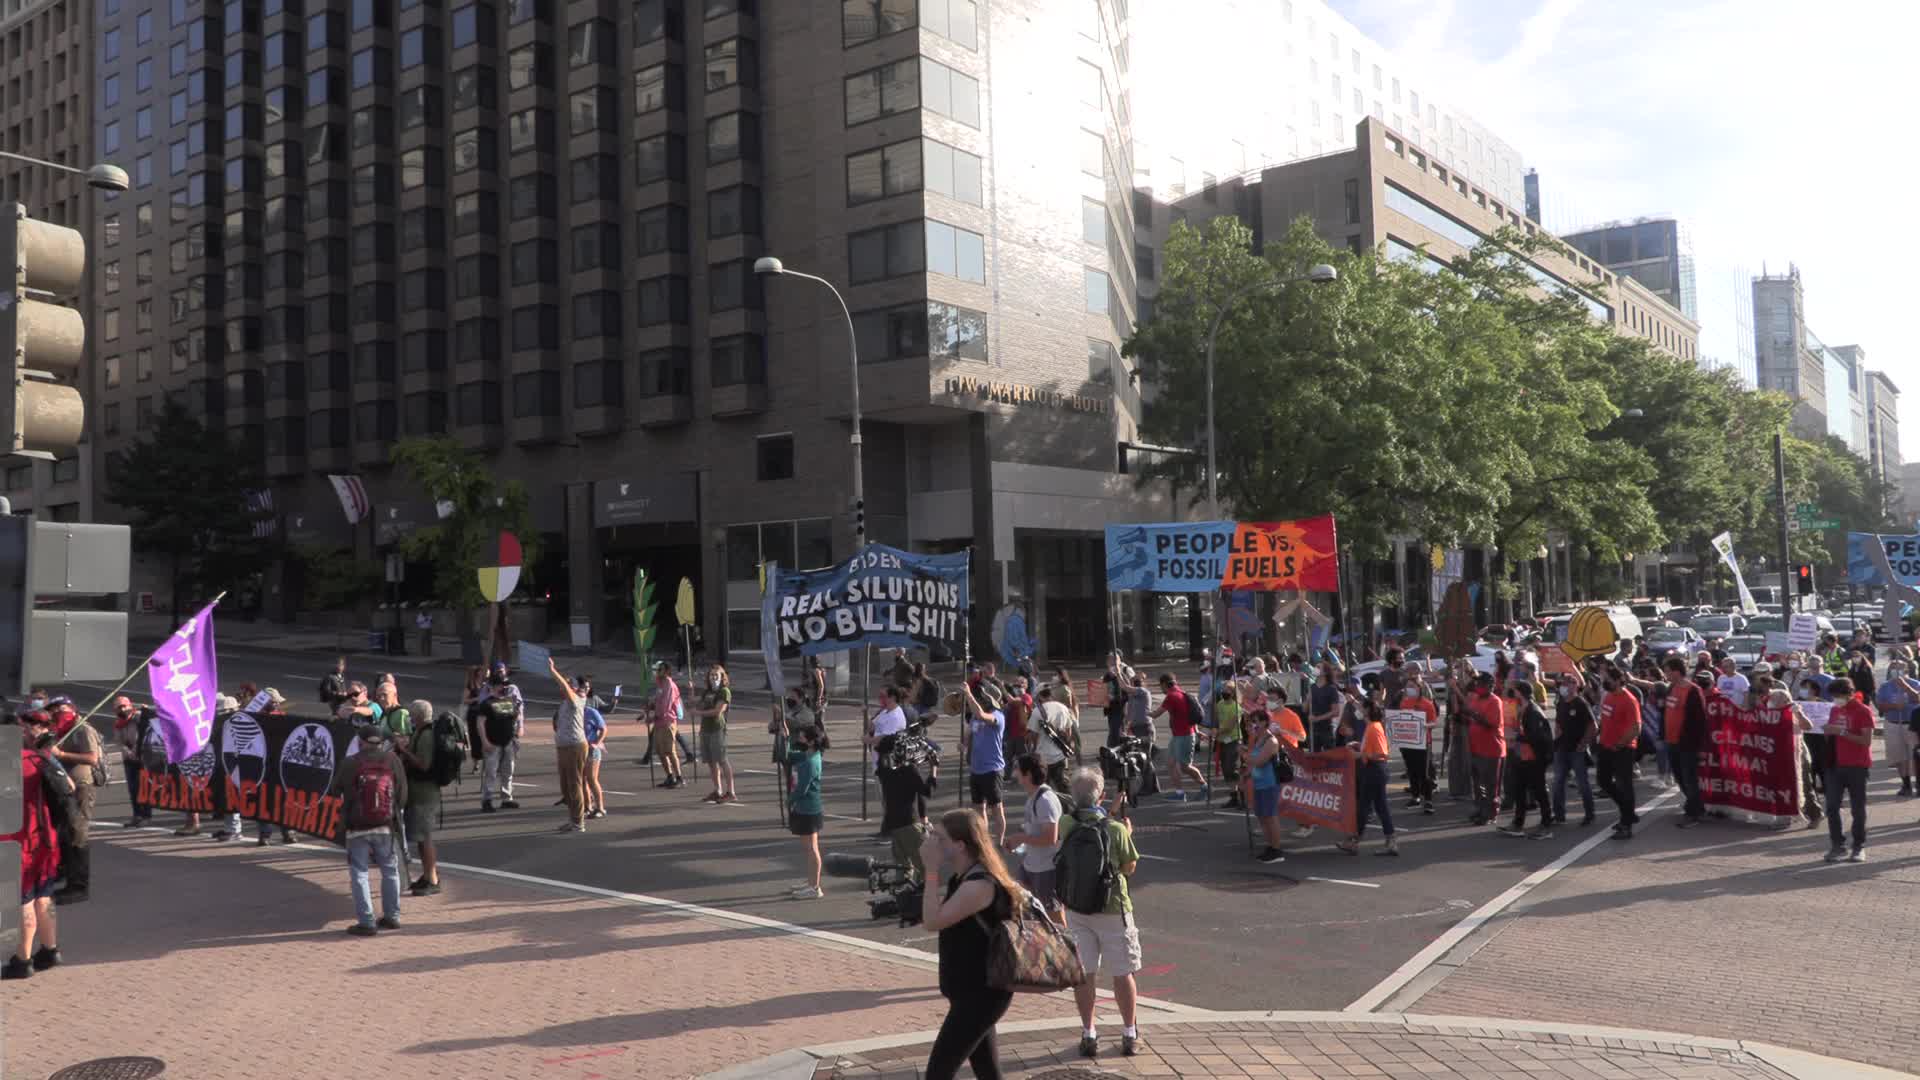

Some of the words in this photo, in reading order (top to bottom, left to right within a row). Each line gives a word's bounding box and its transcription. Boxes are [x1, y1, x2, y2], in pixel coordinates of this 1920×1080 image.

[1156, 531, 1258, 554] PEOPLE
[848, 552, 901, 573] BIDEN
[1158, 556, 1224, 580] FOSSIL
[1231, 556, 1296, 580] FUELS
[780, 588, 840, 617] REAL
[781, 616, 827, 647] NO
[137, 768, 214, 811] DECLARE
[239, 778, 344, 841] CLIMATE
[1281, 785, 1341, 811] CHANGE
